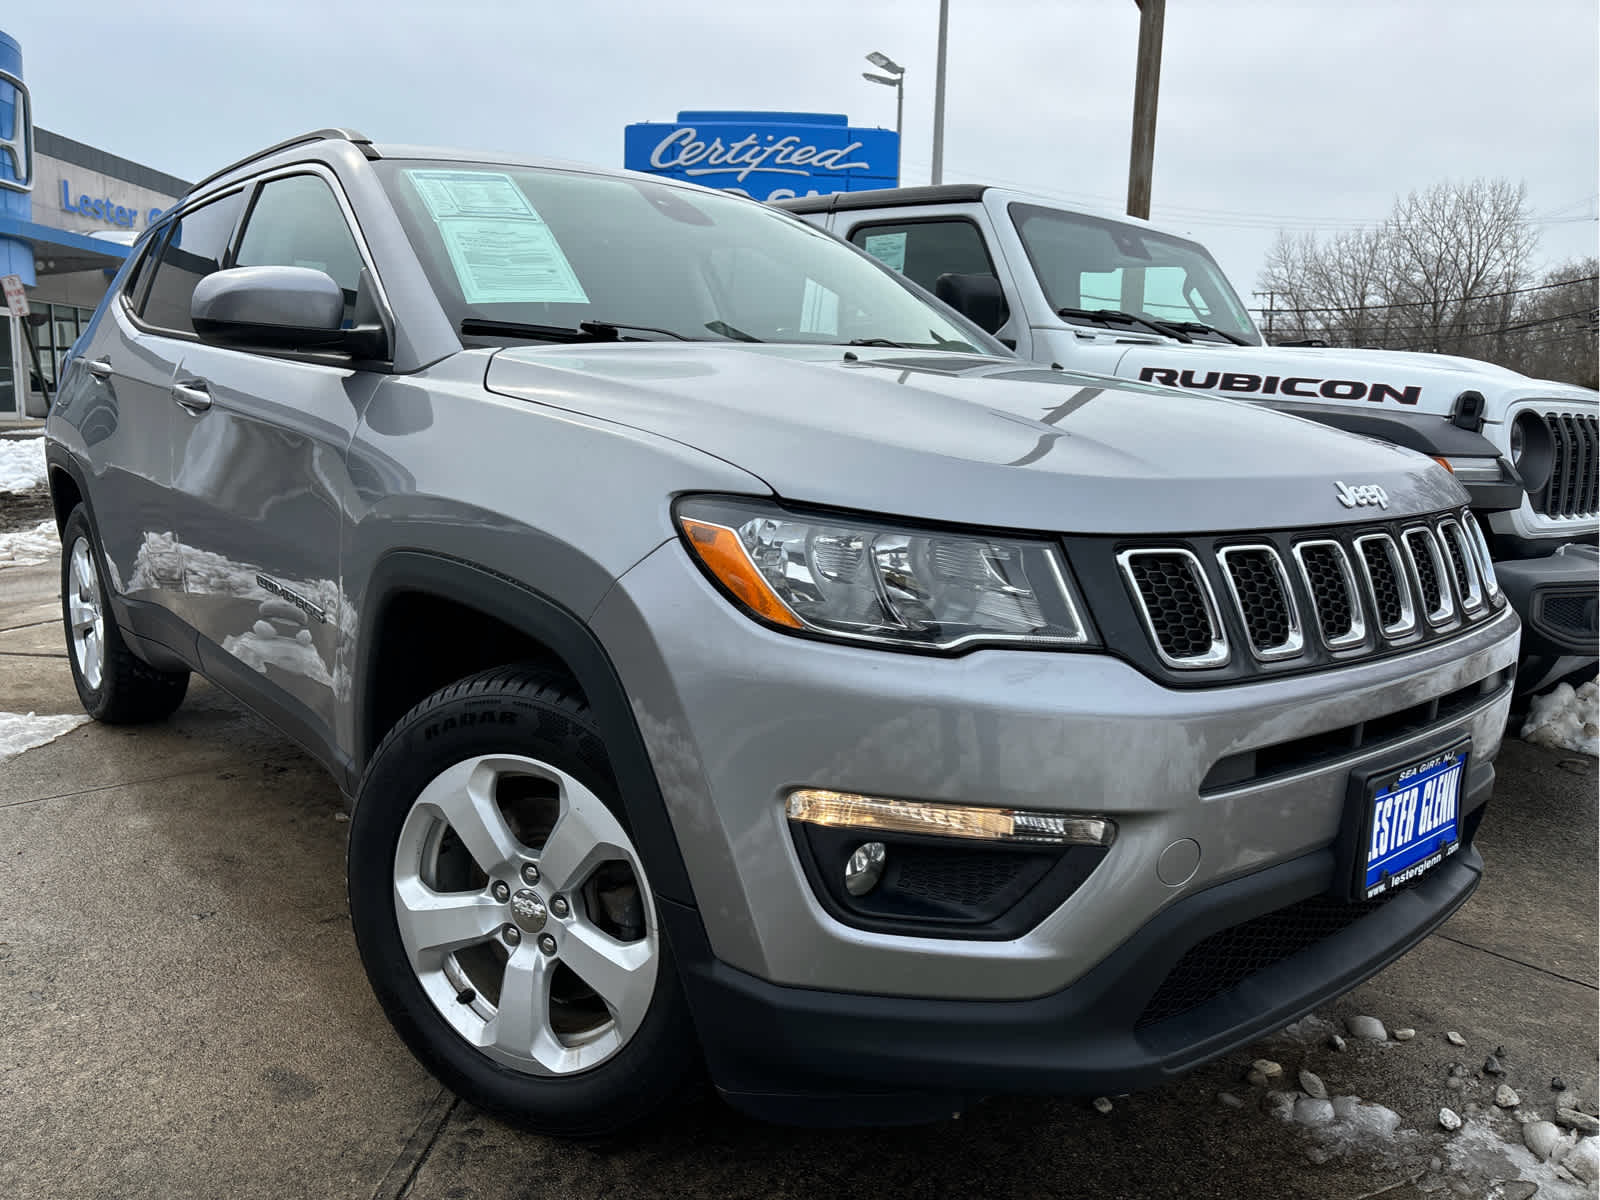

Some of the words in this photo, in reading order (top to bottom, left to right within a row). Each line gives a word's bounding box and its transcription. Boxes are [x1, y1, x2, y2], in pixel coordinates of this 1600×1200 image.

[650, 127, 870, 183] Certified
[61, 179, 138, 229] Lester
[1138, 366, 1423, 406] RUBICON
[1334, 480, 1389, 511] Jeep
[424, 710, 519, 741] RADAR
[1398, 767, 1417, 782] SEA
[1368, 787, 1419, 862] ESTER
[1418, 766, 1460, 836] GLENN
